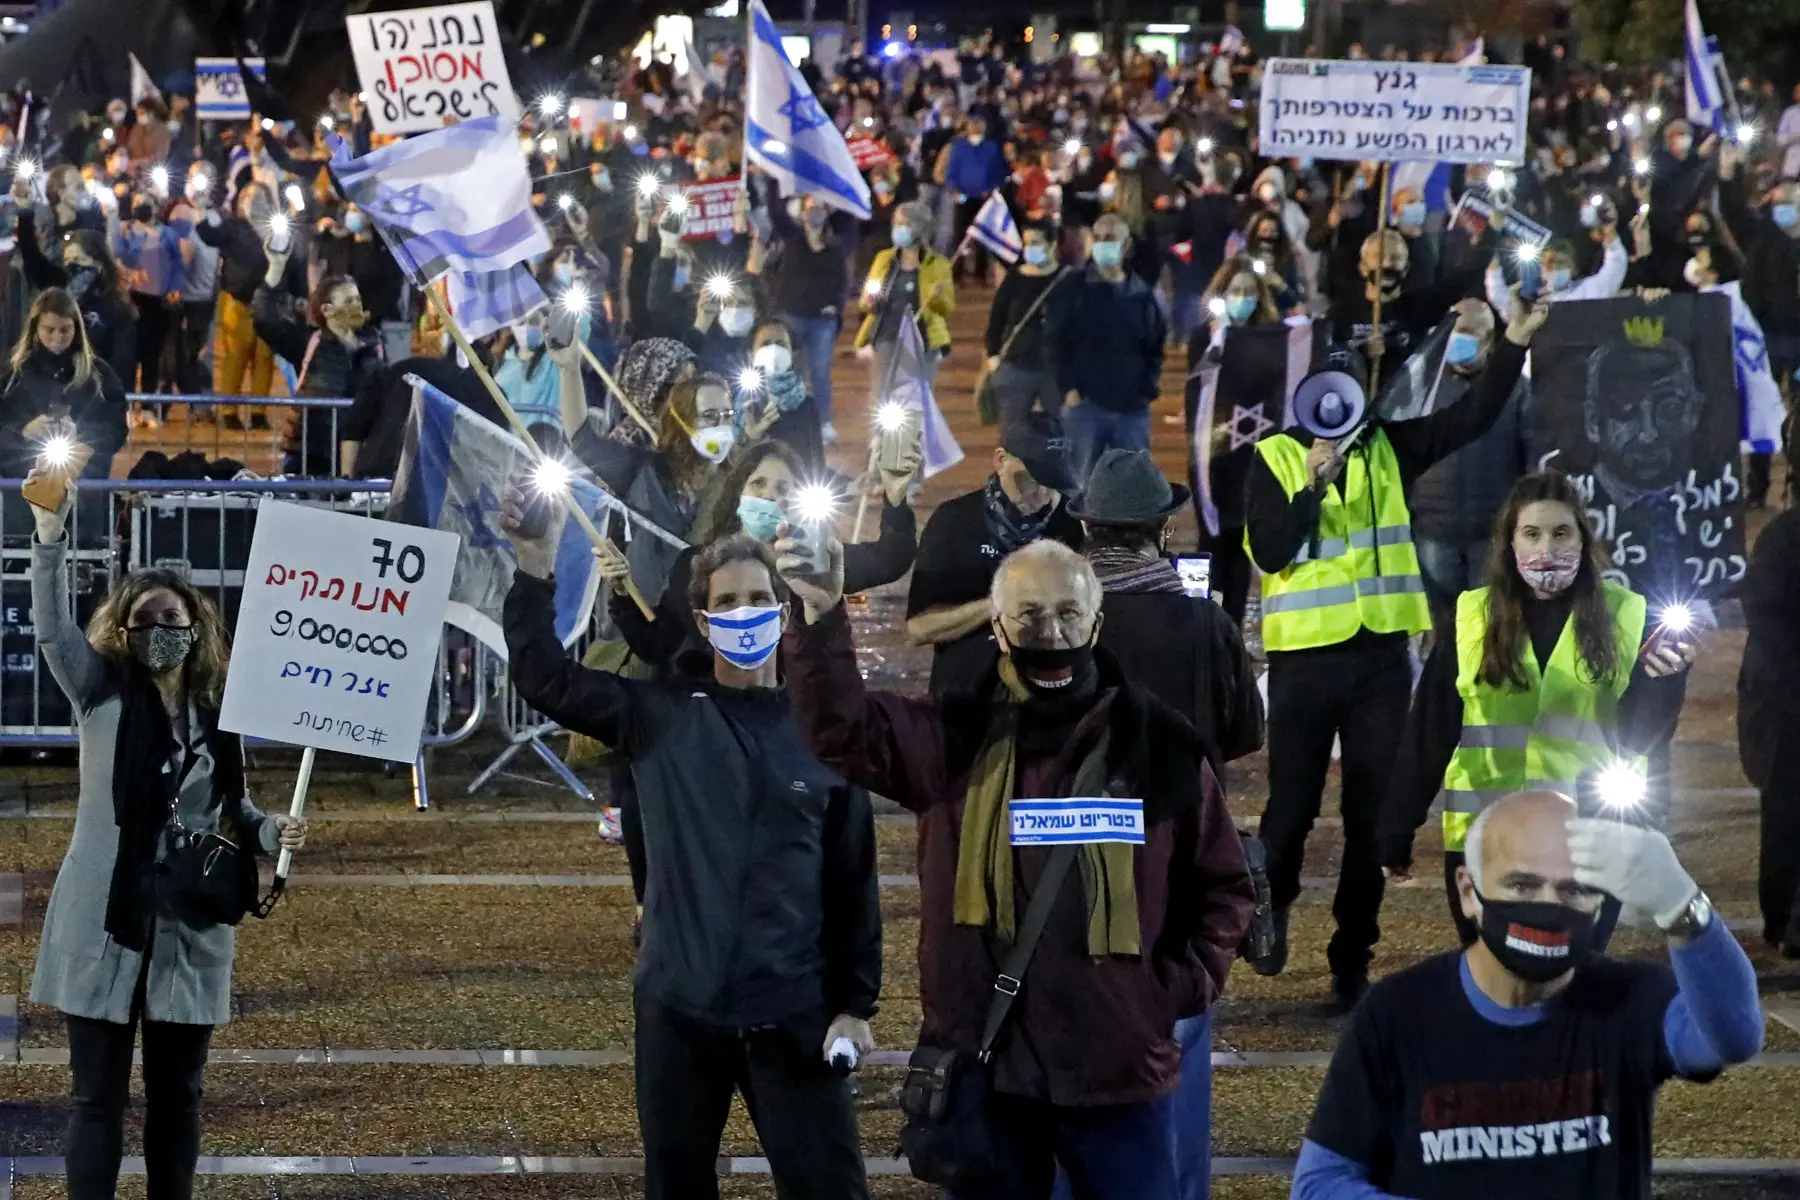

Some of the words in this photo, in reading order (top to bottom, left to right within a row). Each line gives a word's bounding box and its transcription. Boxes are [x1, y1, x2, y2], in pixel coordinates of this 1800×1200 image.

[369, 14, 485, 51] נתניהו
[385, 51, 484, 93] מסוכן
[1374, 70, 1416, 93] גנץ
[375, 79, 499, 122] לישראל
[1269, 99, 1393, 119] הצטרפותך
[1403, 100, 1432, 120] על
[1442, 105, 1514, 122] ברכות
[1272, 129, 1345, 144] נתניהו
[1357, 132, 1426, 148] הפשע
[1437, 132, 1512, 154] לארגון
[1670, 463, 1739, 535] למלך
[1700, 516, 1732, 548] יש
[372, 538, 425, 583] 70
[1684, 555, 1746, 586] כתר
[265, 564, 410, 616] מנותקים
[270, 610, 408, 659] 9,000,000
[280, 661, 390, 698] אזרחים
[293, 711, 389, 747] #שחיתות
[1014, 813, 1075, 829] שמאלני
[1079, 813, 1136, 828] פטריוט
[1420, 1115, 1611, 1164] MINISTER
